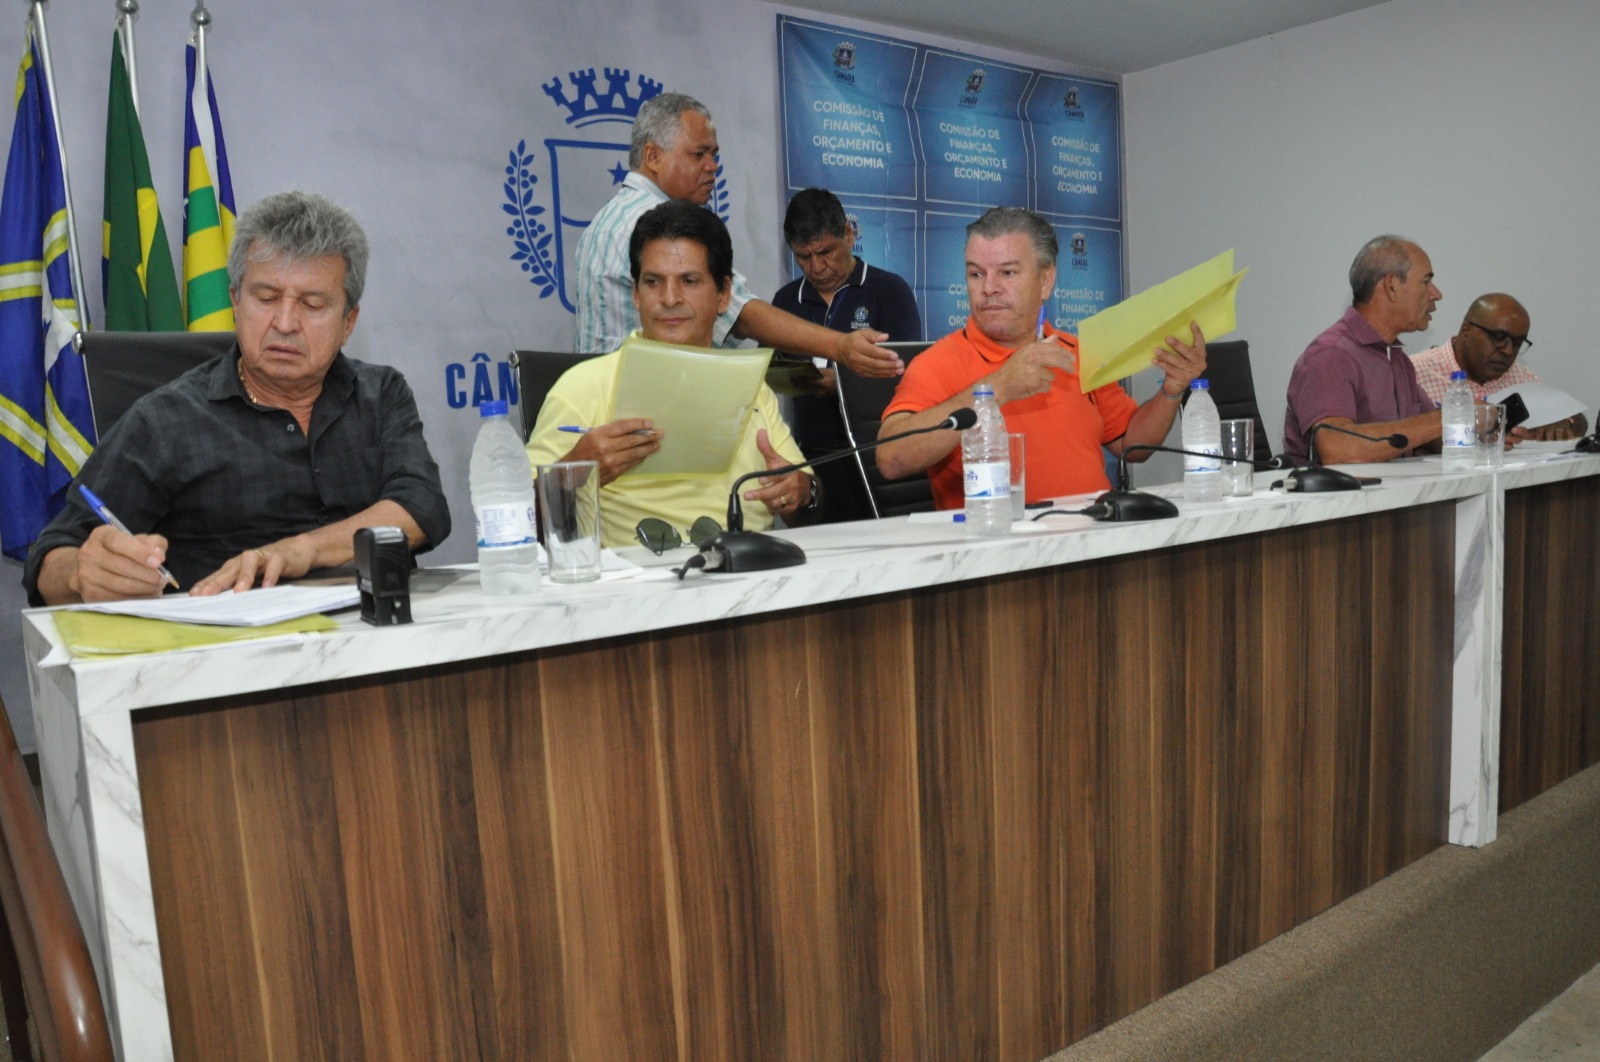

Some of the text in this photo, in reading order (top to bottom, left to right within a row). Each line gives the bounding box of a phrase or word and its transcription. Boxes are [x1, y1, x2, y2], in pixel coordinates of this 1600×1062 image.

[813, 101, 885, 122] COMISSÃO DE
[823, 118, 881, 137] FINANÇAS,
[940, 122, 1000, 140] COMISSÃO DE
[812, 135, 892, 154] ORÇAMENTO E
[949, 138, 997, 155] FINANÇAS,
[1051, 136, 1100, 153] COMISSÃO DE
[822, 152, 884, 169] ECONOMIA
[944, 152, 1008, 169] ORÇAMENTO E
[1059, 151, 1095, 168] FINANÇAS,
[954, 166, 1002, 182] ECONOMIA
[1052, 165, 1103, 182] ORÇAMENTO E
[1057, 181, 1098, 195] ECONOMIA
[1054, 287, 1105, 301] COMISSÃO DE
